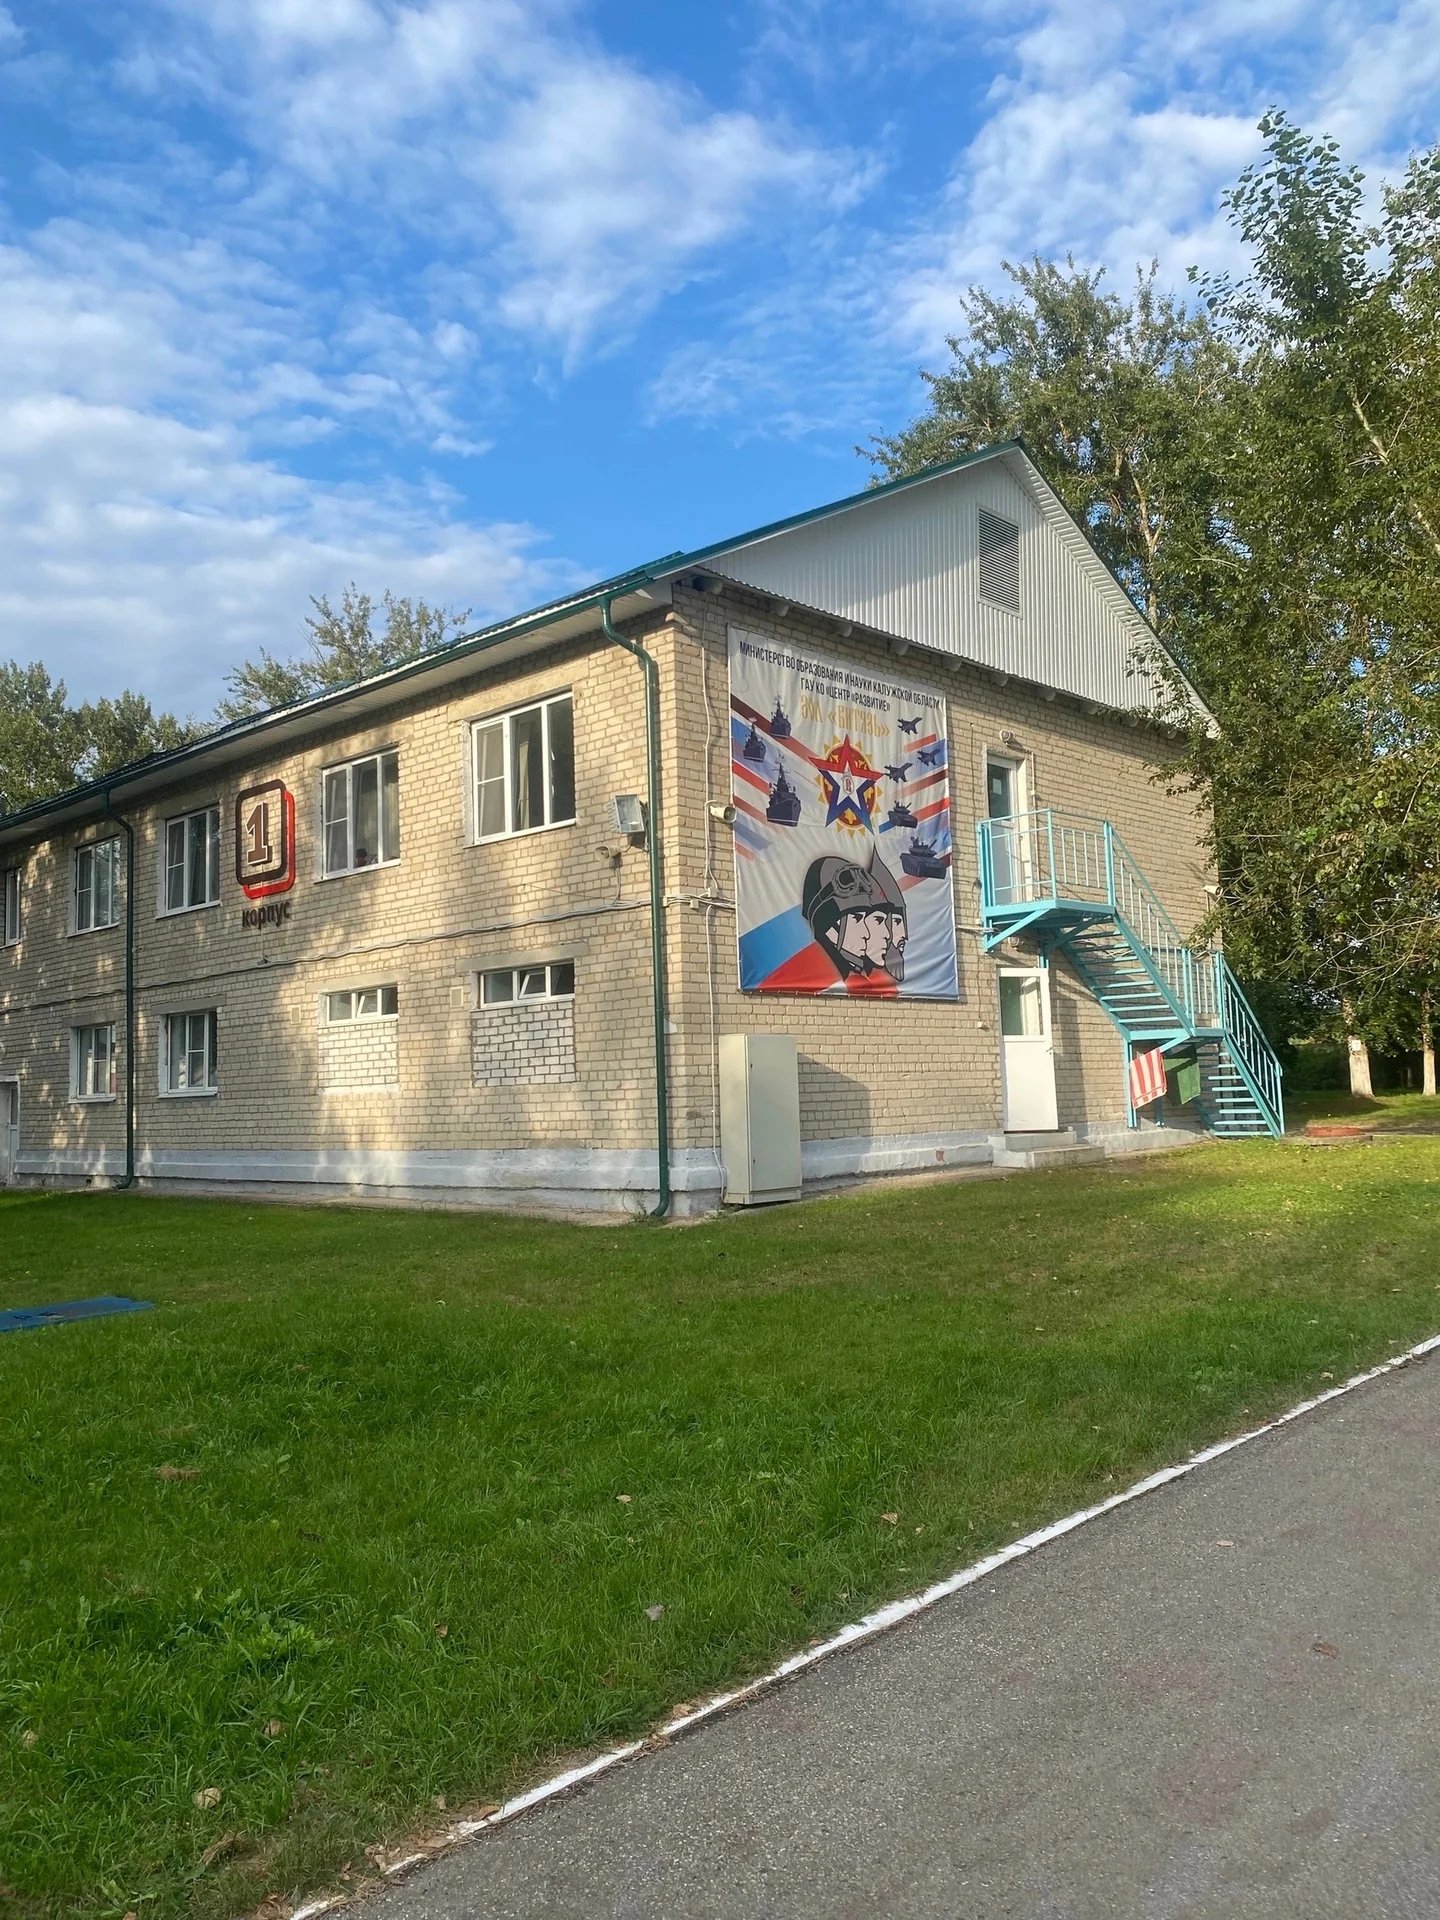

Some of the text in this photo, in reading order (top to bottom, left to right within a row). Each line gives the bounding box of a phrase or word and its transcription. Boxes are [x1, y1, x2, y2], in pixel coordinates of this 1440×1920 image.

[739, 641, 940, 709] МИНИСТЕРСТВО ОБРАЗОВАНИЯ И НАУКИ КАЛУЖСКОЙ ОБЛАСТИ
[801, 678, 815, 692] ГАУ
[816, 682, 825, 695] КО
[246, 801, 272, 867] 1
[242, 901, 291, 930] корпус
